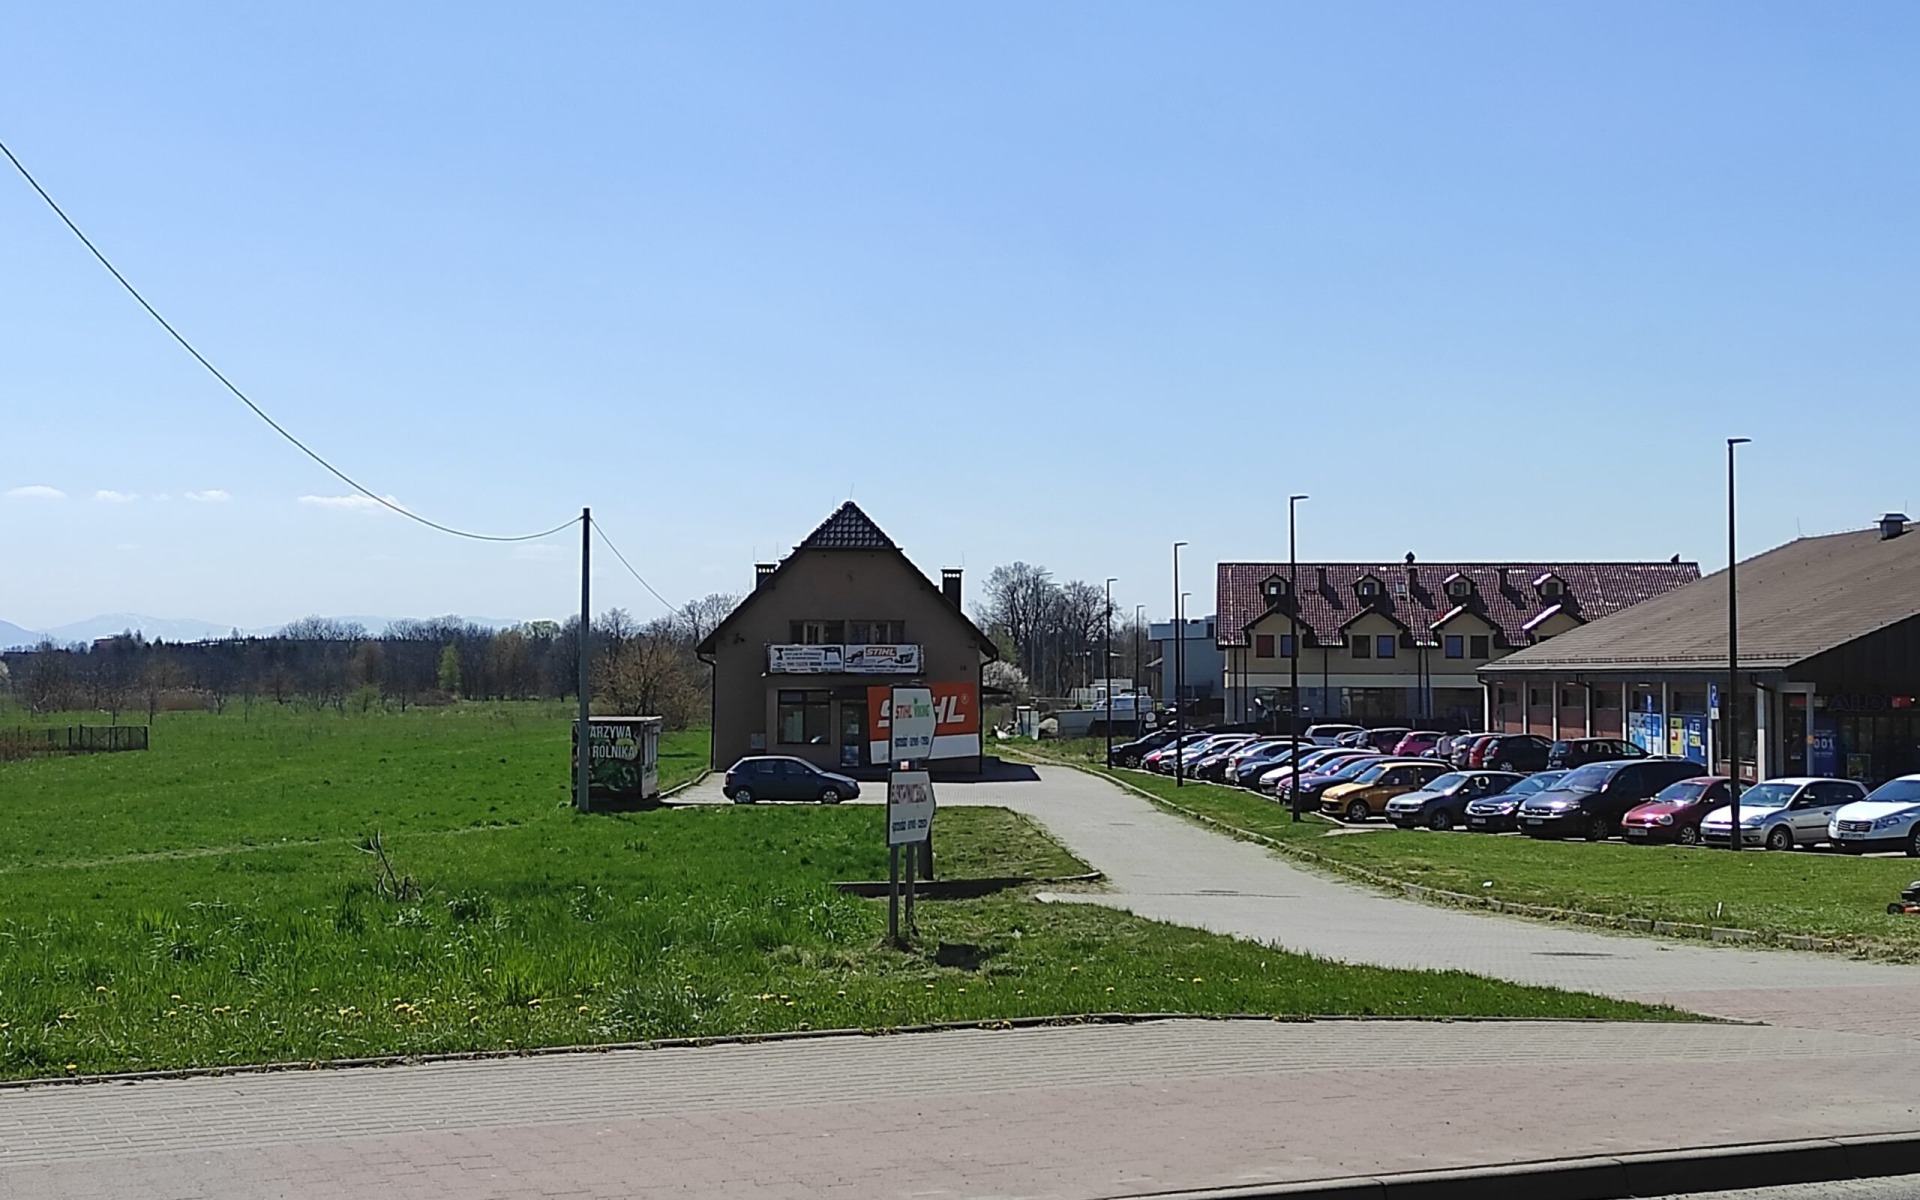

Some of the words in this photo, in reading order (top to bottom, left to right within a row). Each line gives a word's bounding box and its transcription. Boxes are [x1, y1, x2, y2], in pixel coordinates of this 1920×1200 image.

[866, 648, 896, 656] STIHL
[1827, 694, 1890, 712] ALDI
[592, 745, 635, 758] ROLNIKA
